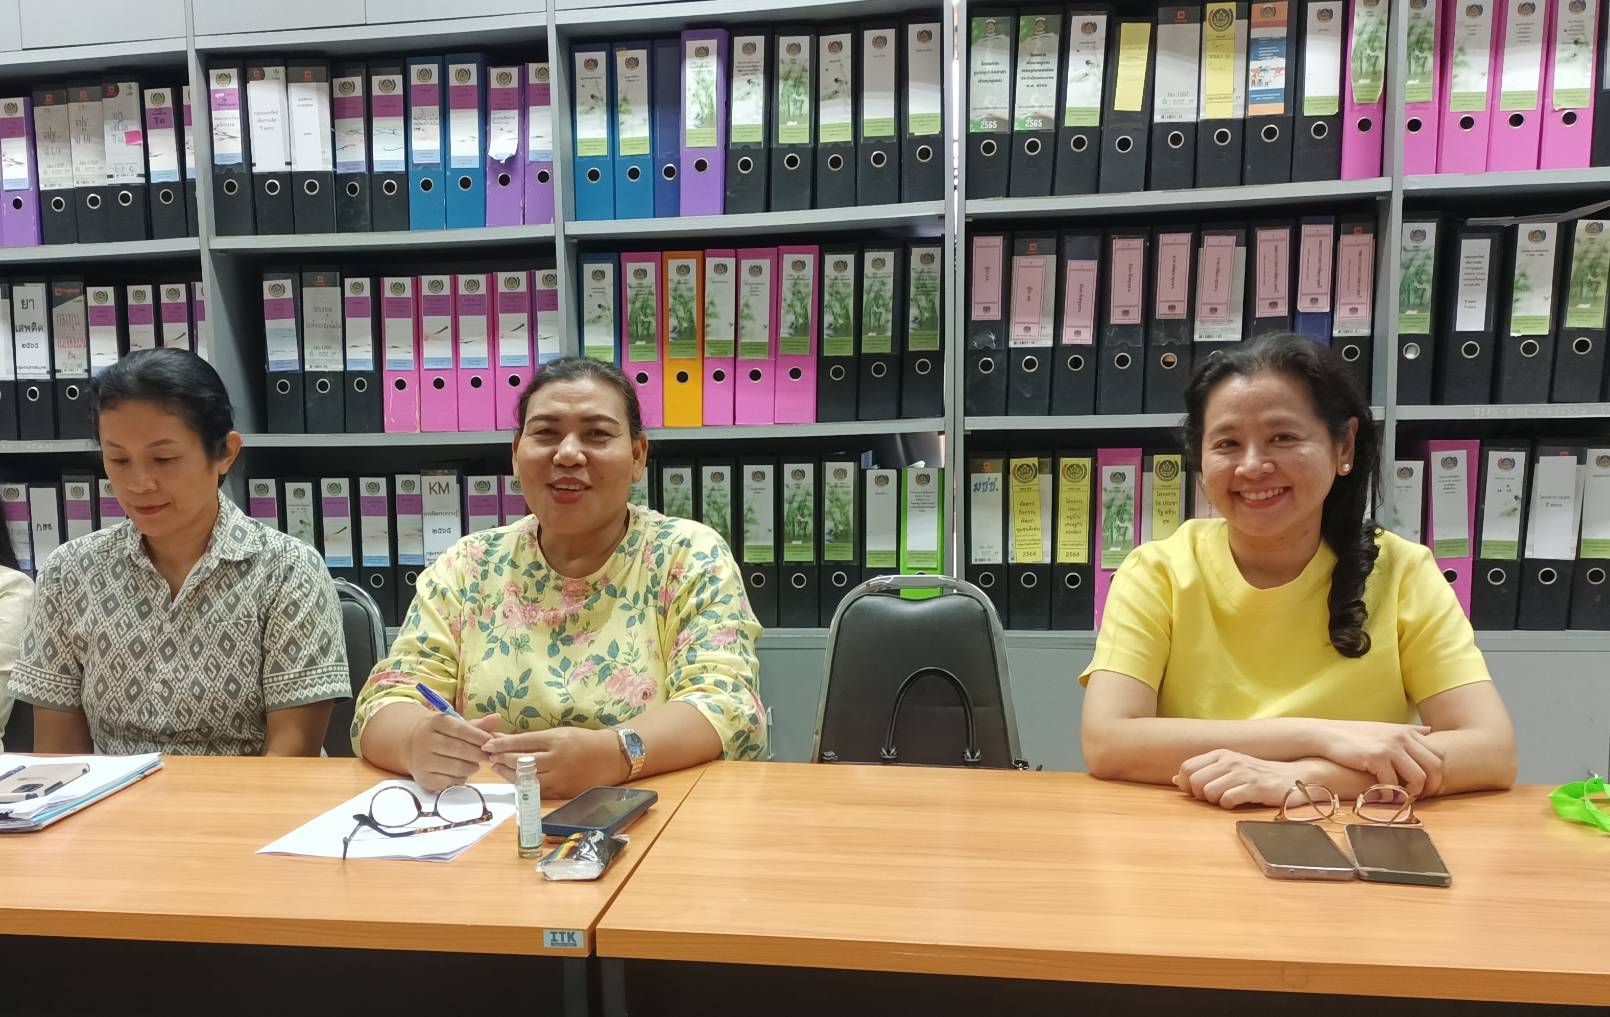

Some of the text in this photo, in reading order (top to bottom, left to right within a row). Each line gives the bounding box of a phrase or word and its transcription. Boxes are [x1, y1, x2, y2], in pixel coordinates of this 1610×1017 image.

[980, 121, 998, 129] 2565
[1025, 119, 1043, 128] 2565
[21, 298, 35, 310] ยา
[16, 322, 44, 333] เสพติด
[428, 481, 450, 496] KM
[550, 932, 576, 943] ITK
